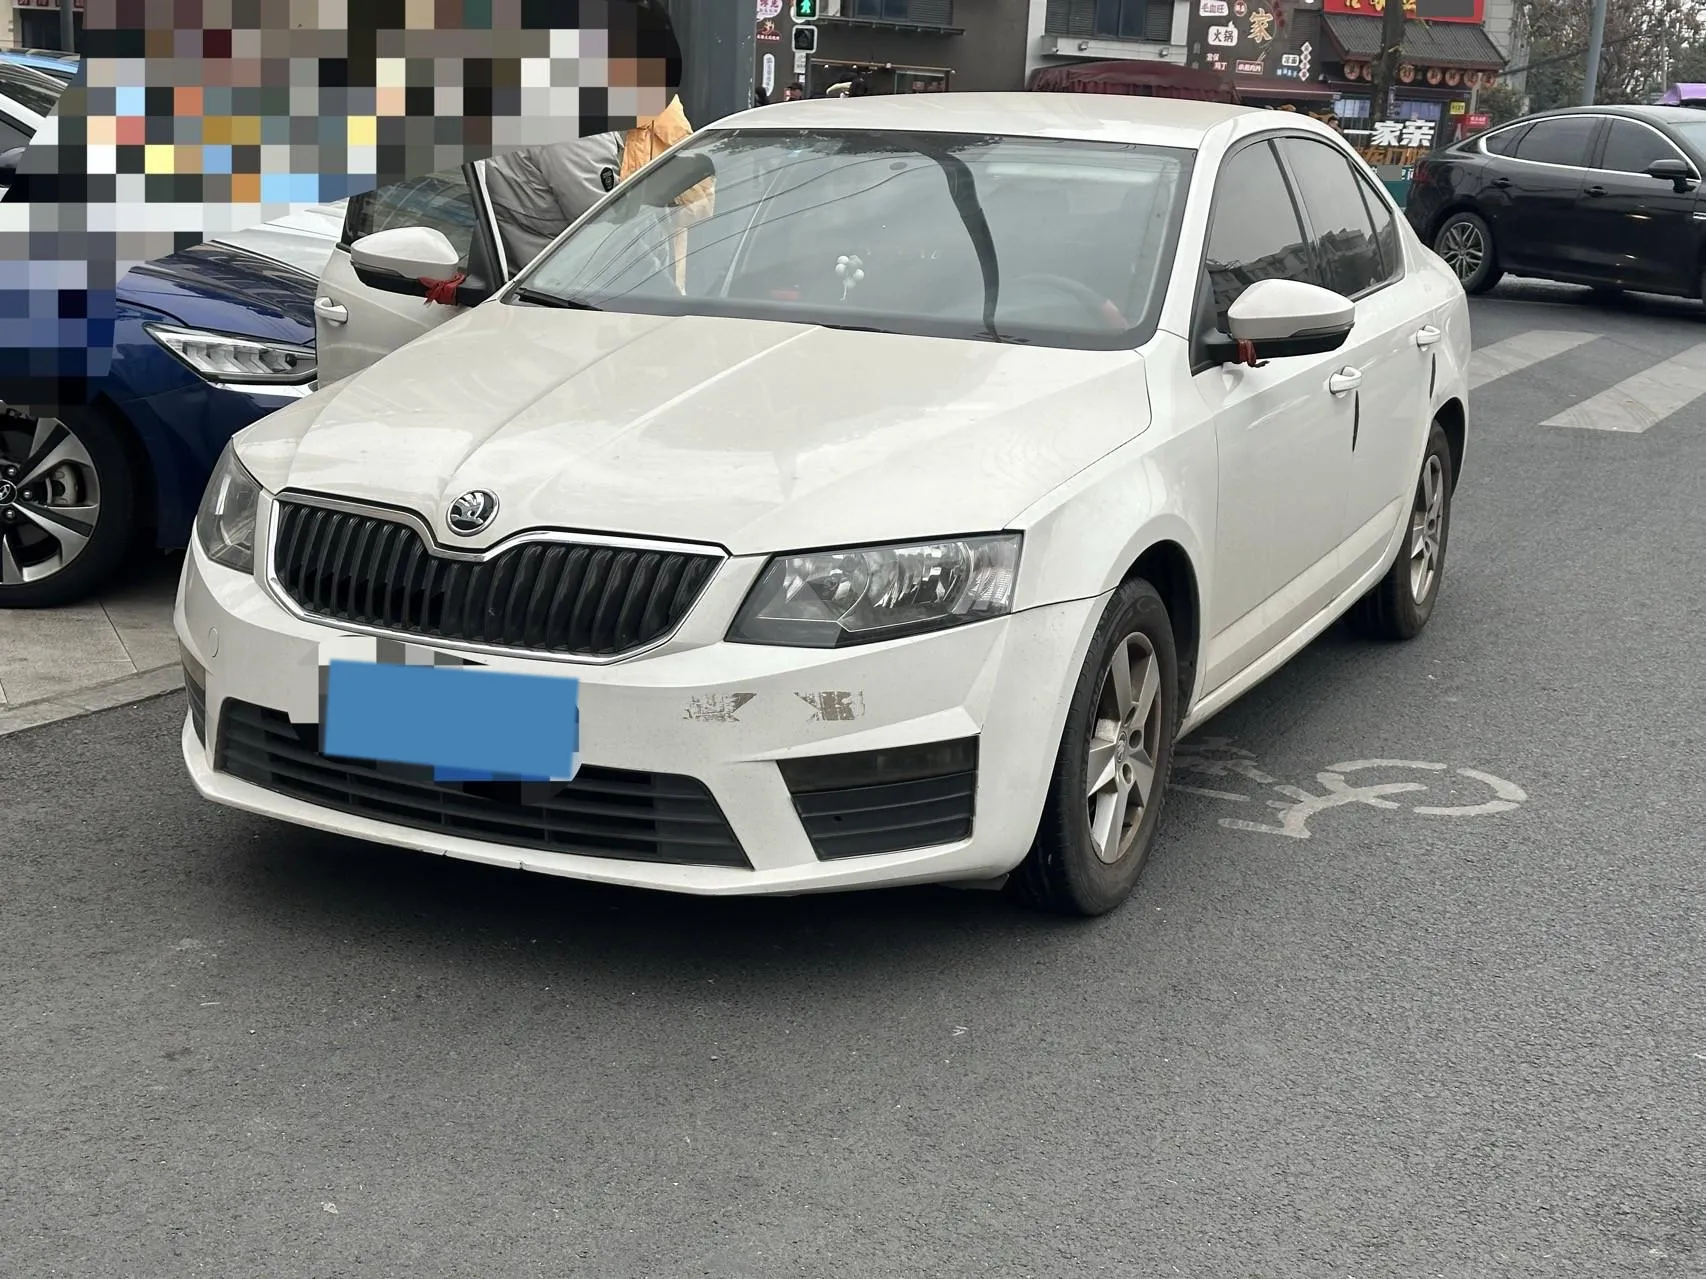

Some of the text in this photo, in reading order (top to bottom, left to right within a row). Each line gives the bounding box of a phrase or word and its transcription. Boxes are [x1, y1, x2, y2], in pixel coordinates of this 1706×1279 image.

[1213, 29, 1235, 43] 火锅
[1247, 7, 1274, 43] 家
[1343, 120, 1436, 147] 一家亲
